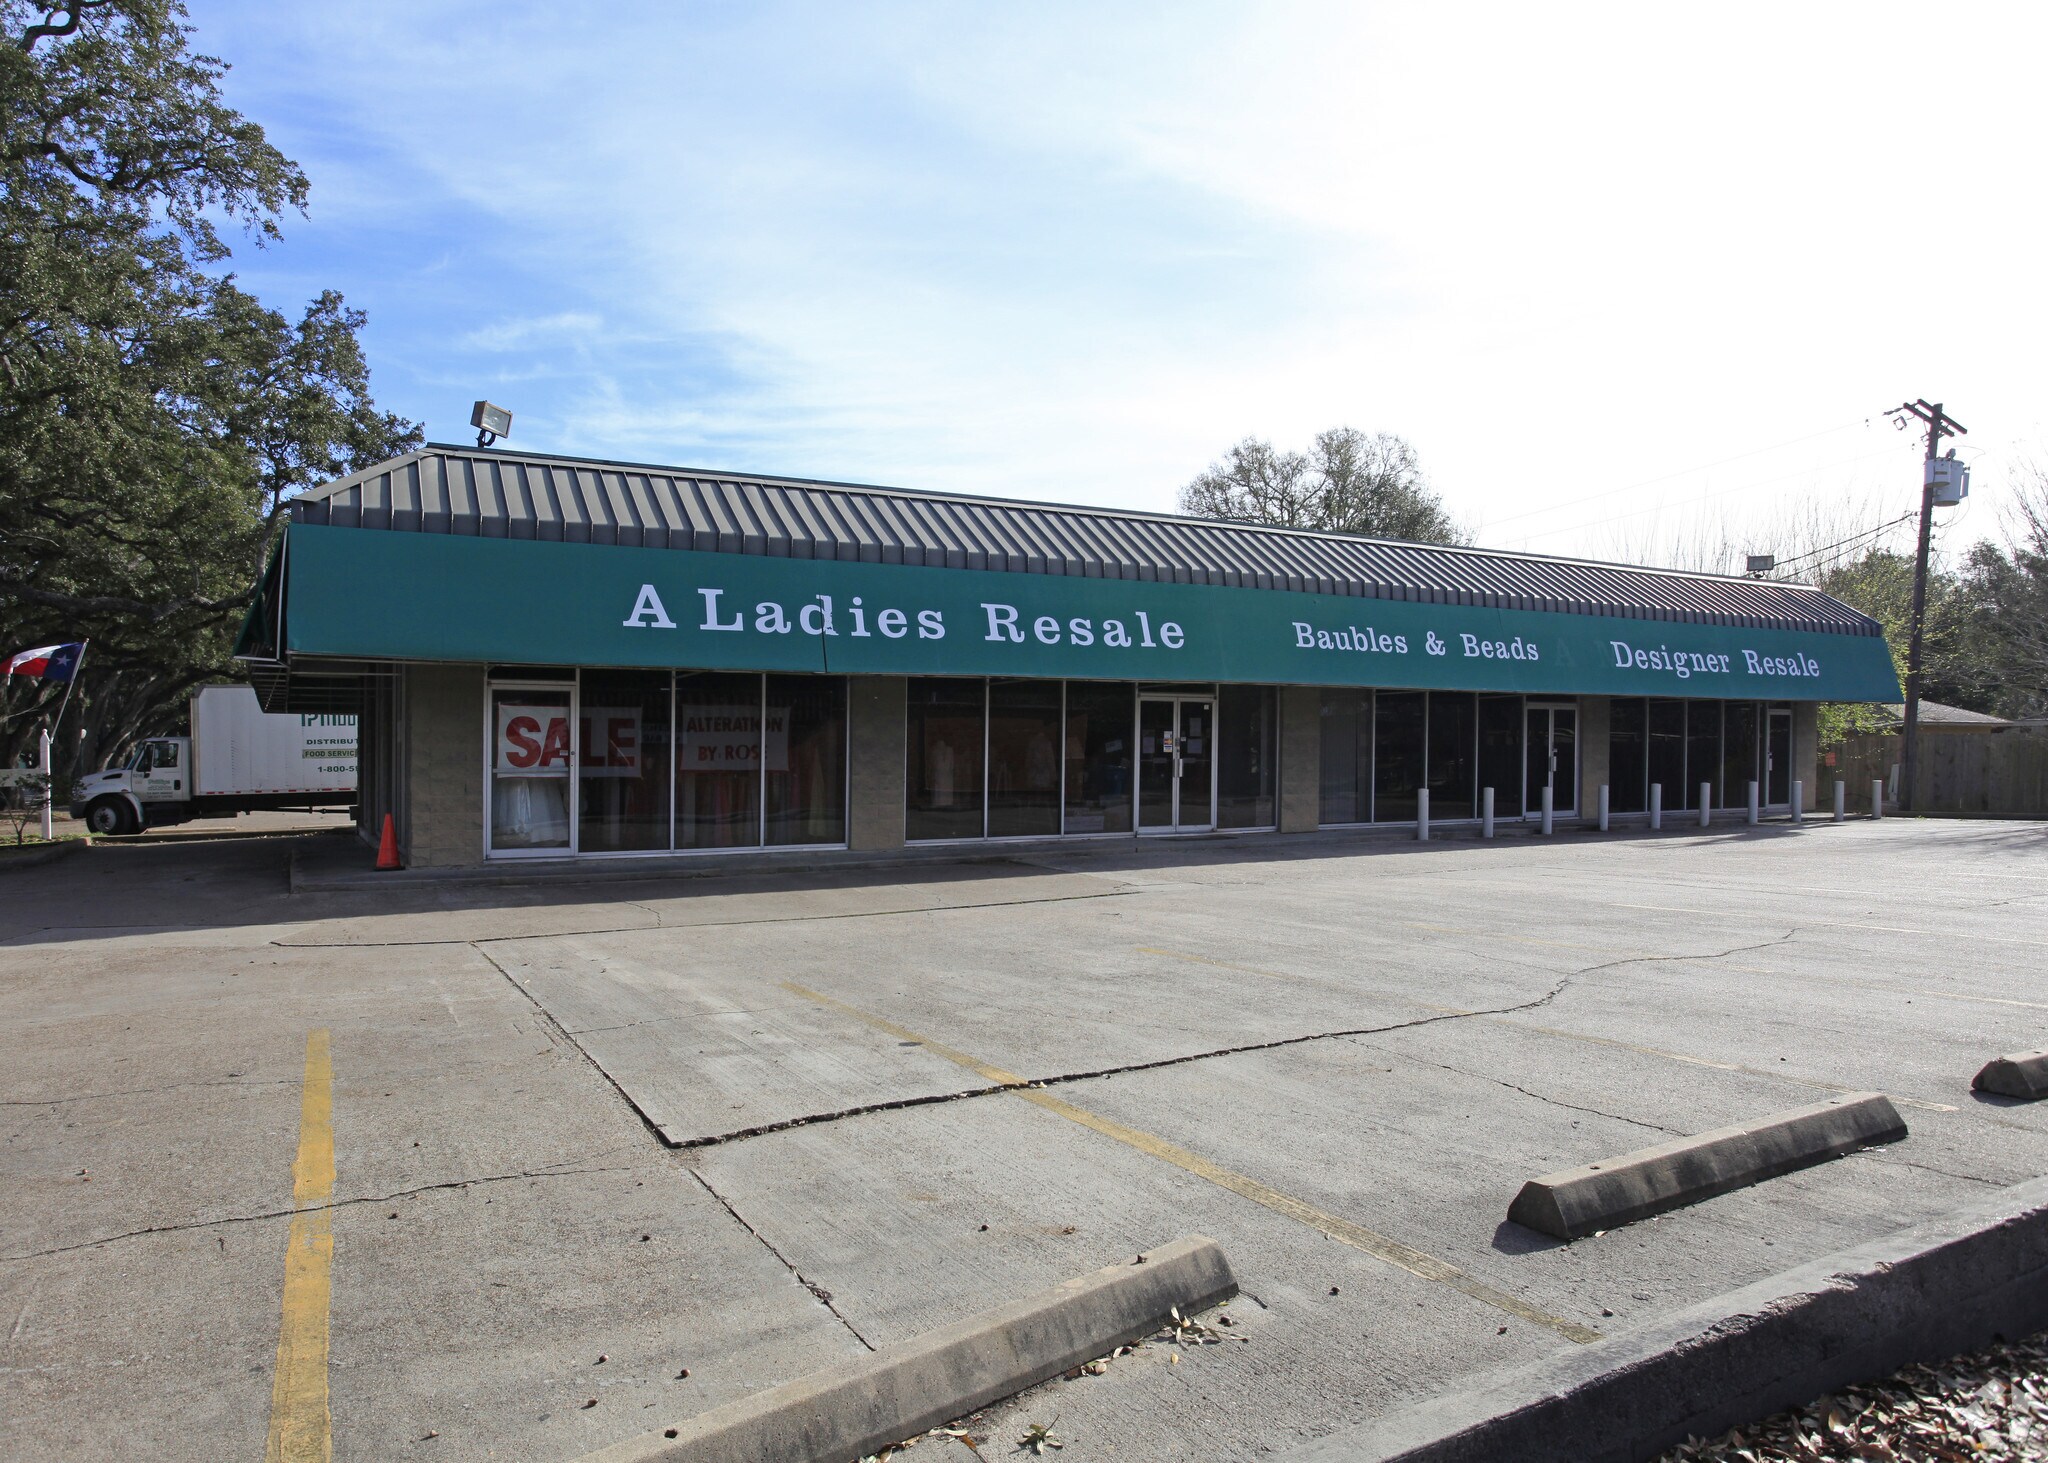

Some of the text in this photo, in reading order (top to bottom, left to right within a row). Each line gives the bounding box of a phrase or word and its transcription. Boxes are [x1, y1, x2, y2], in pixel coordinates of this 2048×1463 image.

[622, 584, 1185, 649] A Ladies Resale
[1292, 621, 1540, 663] Baubles & Beads
[1610, 640, 1730, 680] Designer
[1742, 649, 1820, 678] Resale
[304, 750, 326, 758] FOOD
[505, 716, 635, 768] SALE
[698, 744, 768, 761] BY ROS
